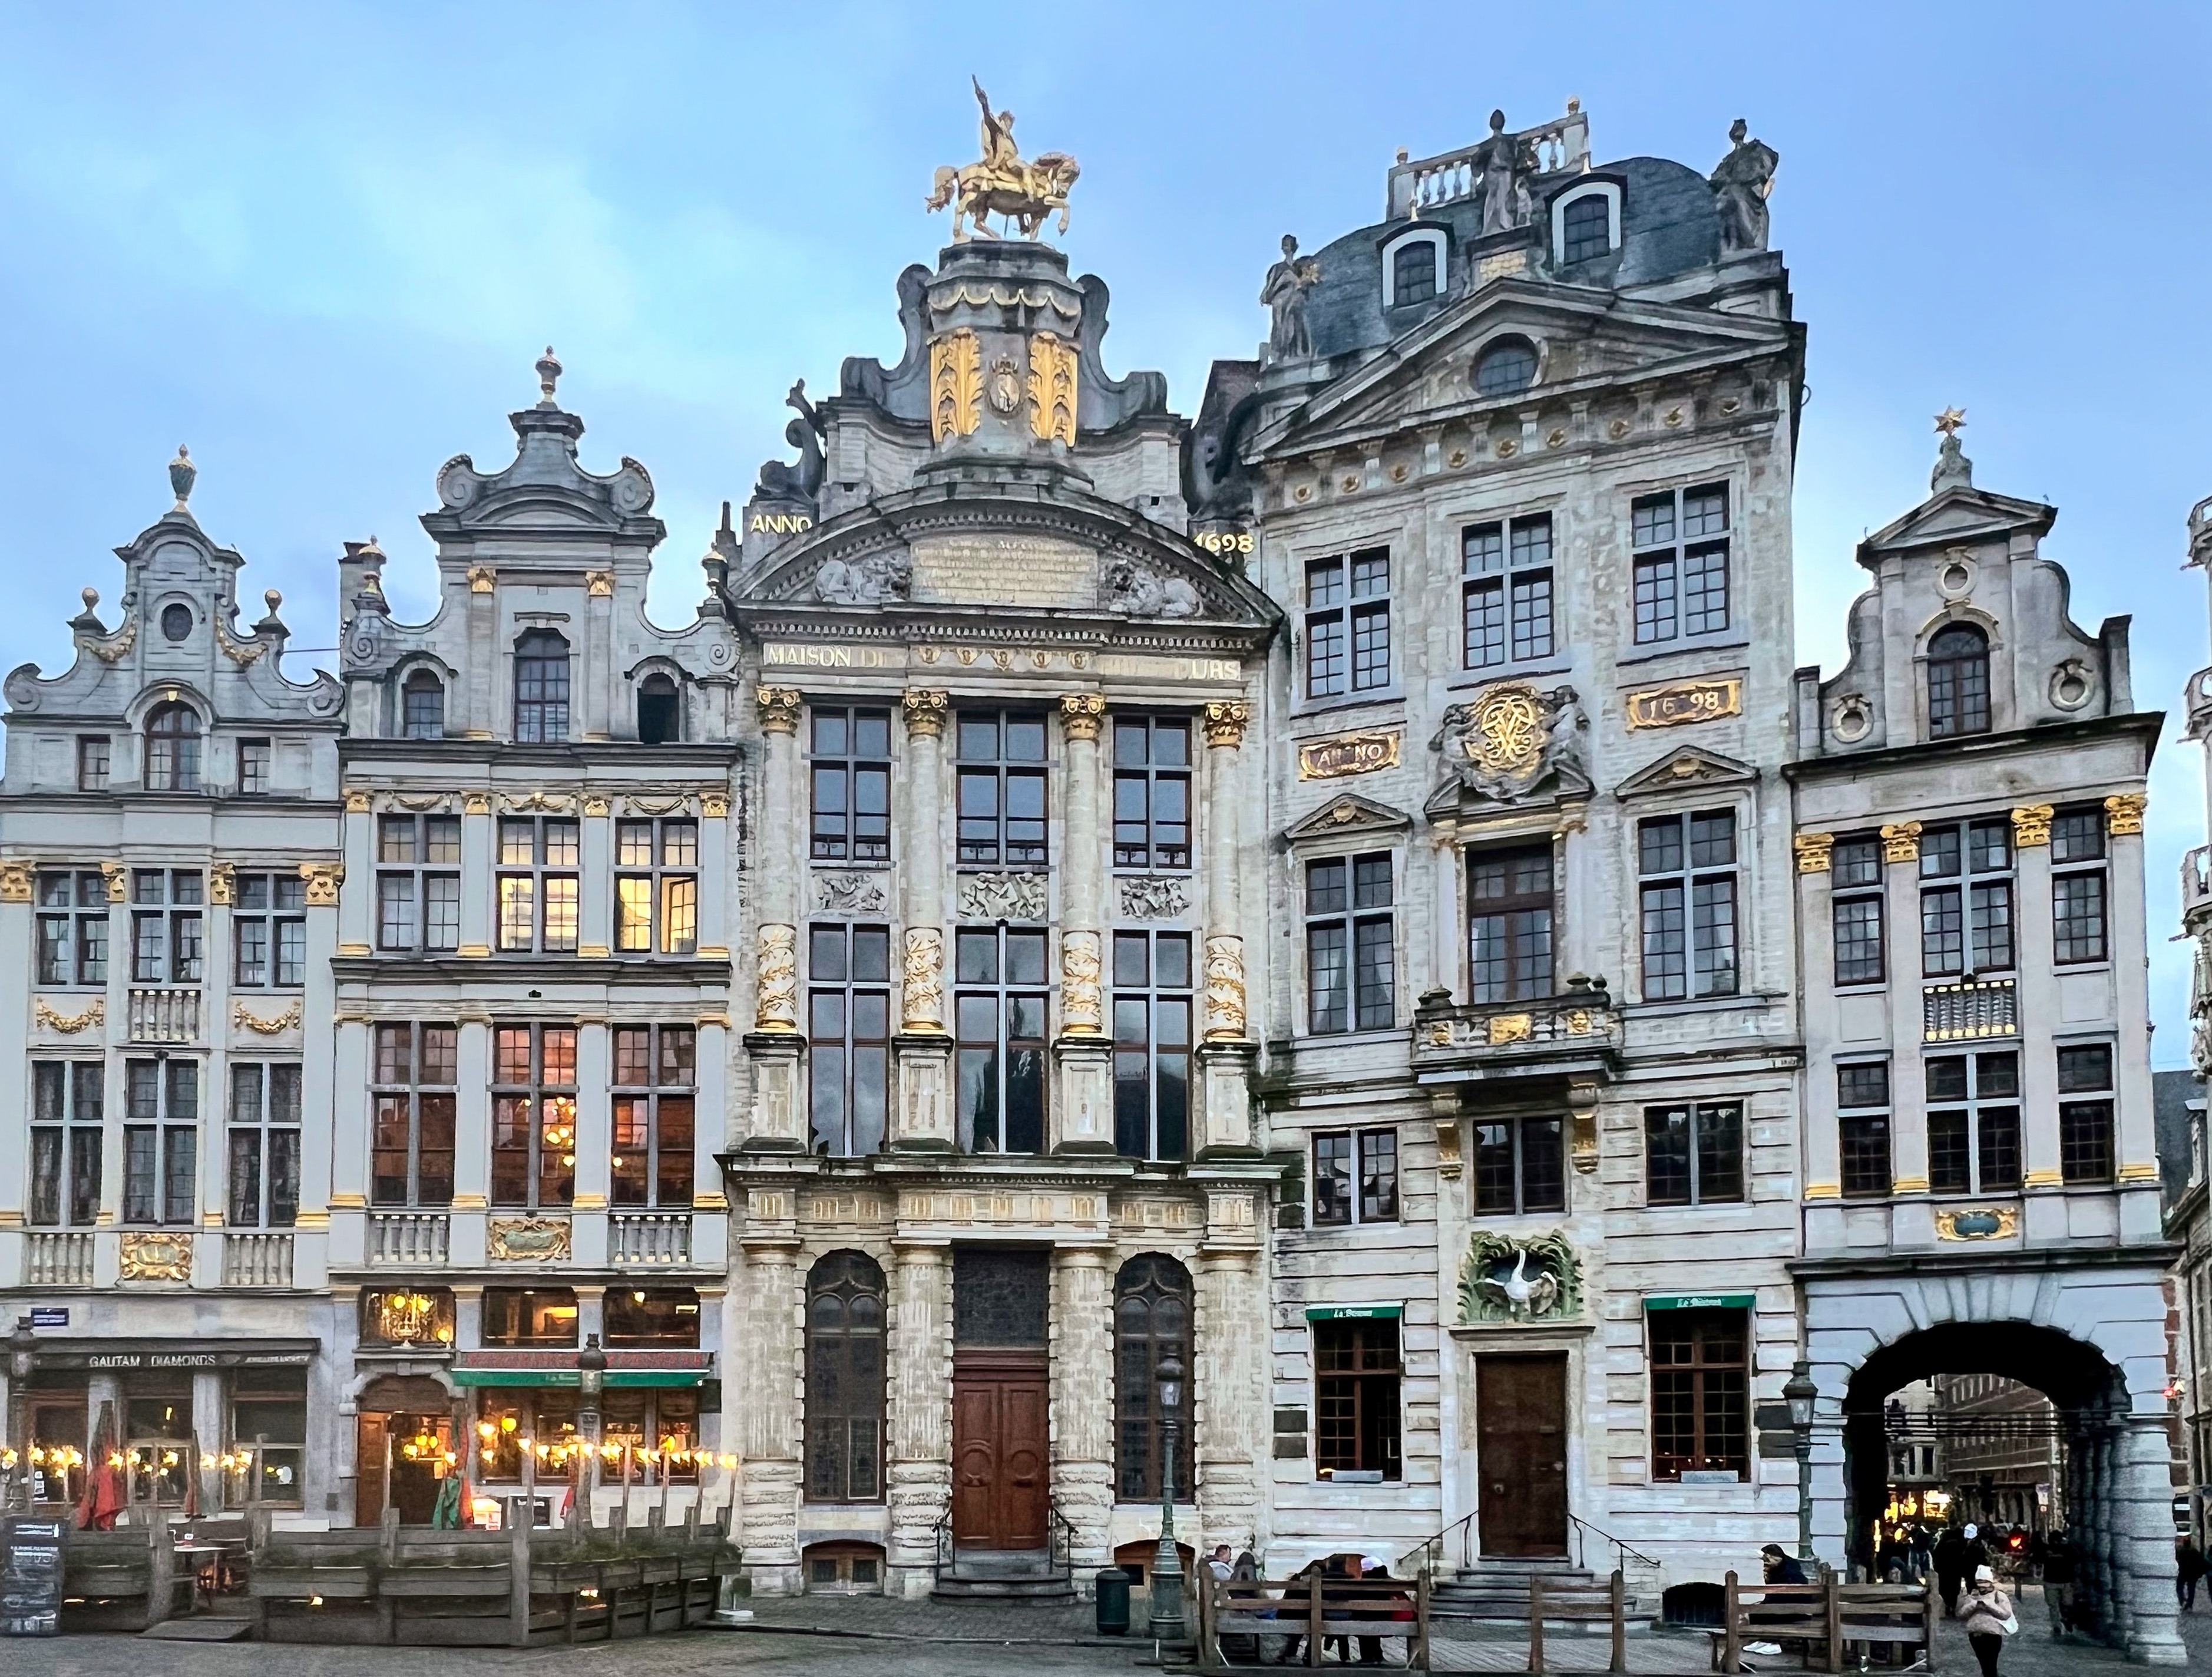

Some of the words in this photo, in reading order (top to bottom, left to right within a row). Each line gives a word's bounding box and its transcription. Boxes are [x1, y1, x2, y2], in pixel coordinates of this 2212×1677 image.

[750, 514, 812, 533] ANNO
[1193, 532, 1254, 553] 1698
[768, 645, 851, 667] MAISON
[89, 1355, 140, 1367] GAUTAM
[151, 1355, 216, 1366] DIAMONDS
